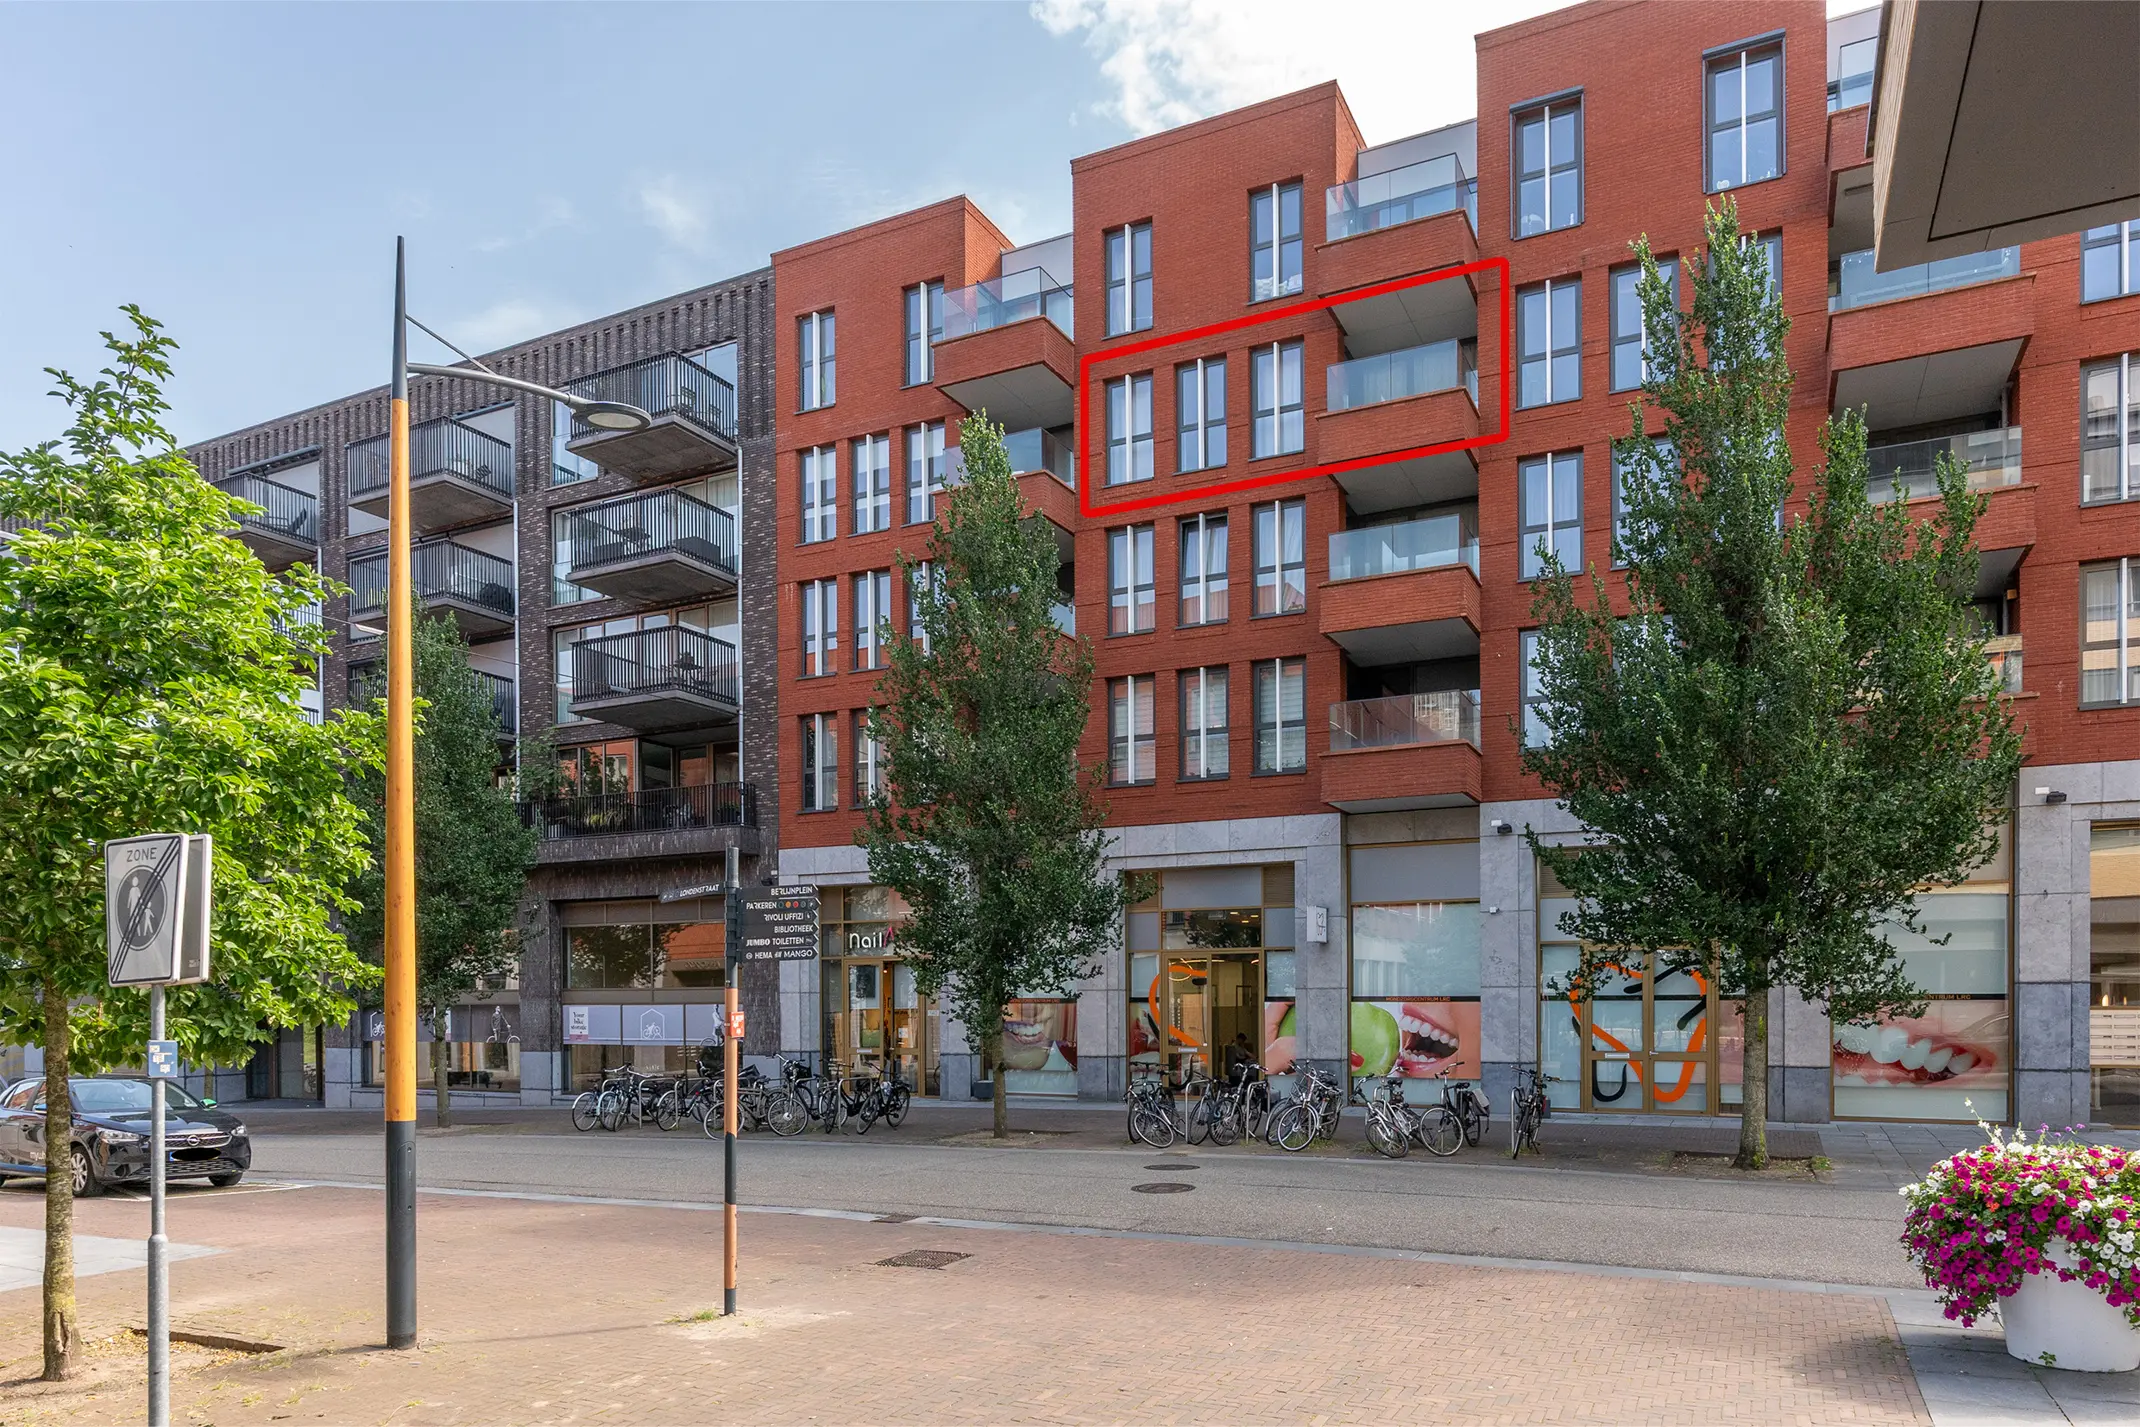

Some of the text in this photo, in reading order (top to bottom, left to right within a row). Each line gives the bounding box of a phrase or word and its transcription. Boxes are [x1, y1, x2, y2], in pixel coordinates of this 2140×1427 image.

[127, 847, 157, 863] ZONE
[770, 886, 813, 896] BERLIJNPLEIN
[746, 902, 777, 910] PARKEREN
[763, 912, 804, 921] RIVOLI UFFIZI
[774, 924, 814, 933] BIBLIOTHEEK
[746, 936, 805, 947] JUMBO TOILETTEN
[754, 951, 773, 960] HEMA
[783, 949, 813, 958] MANGO
